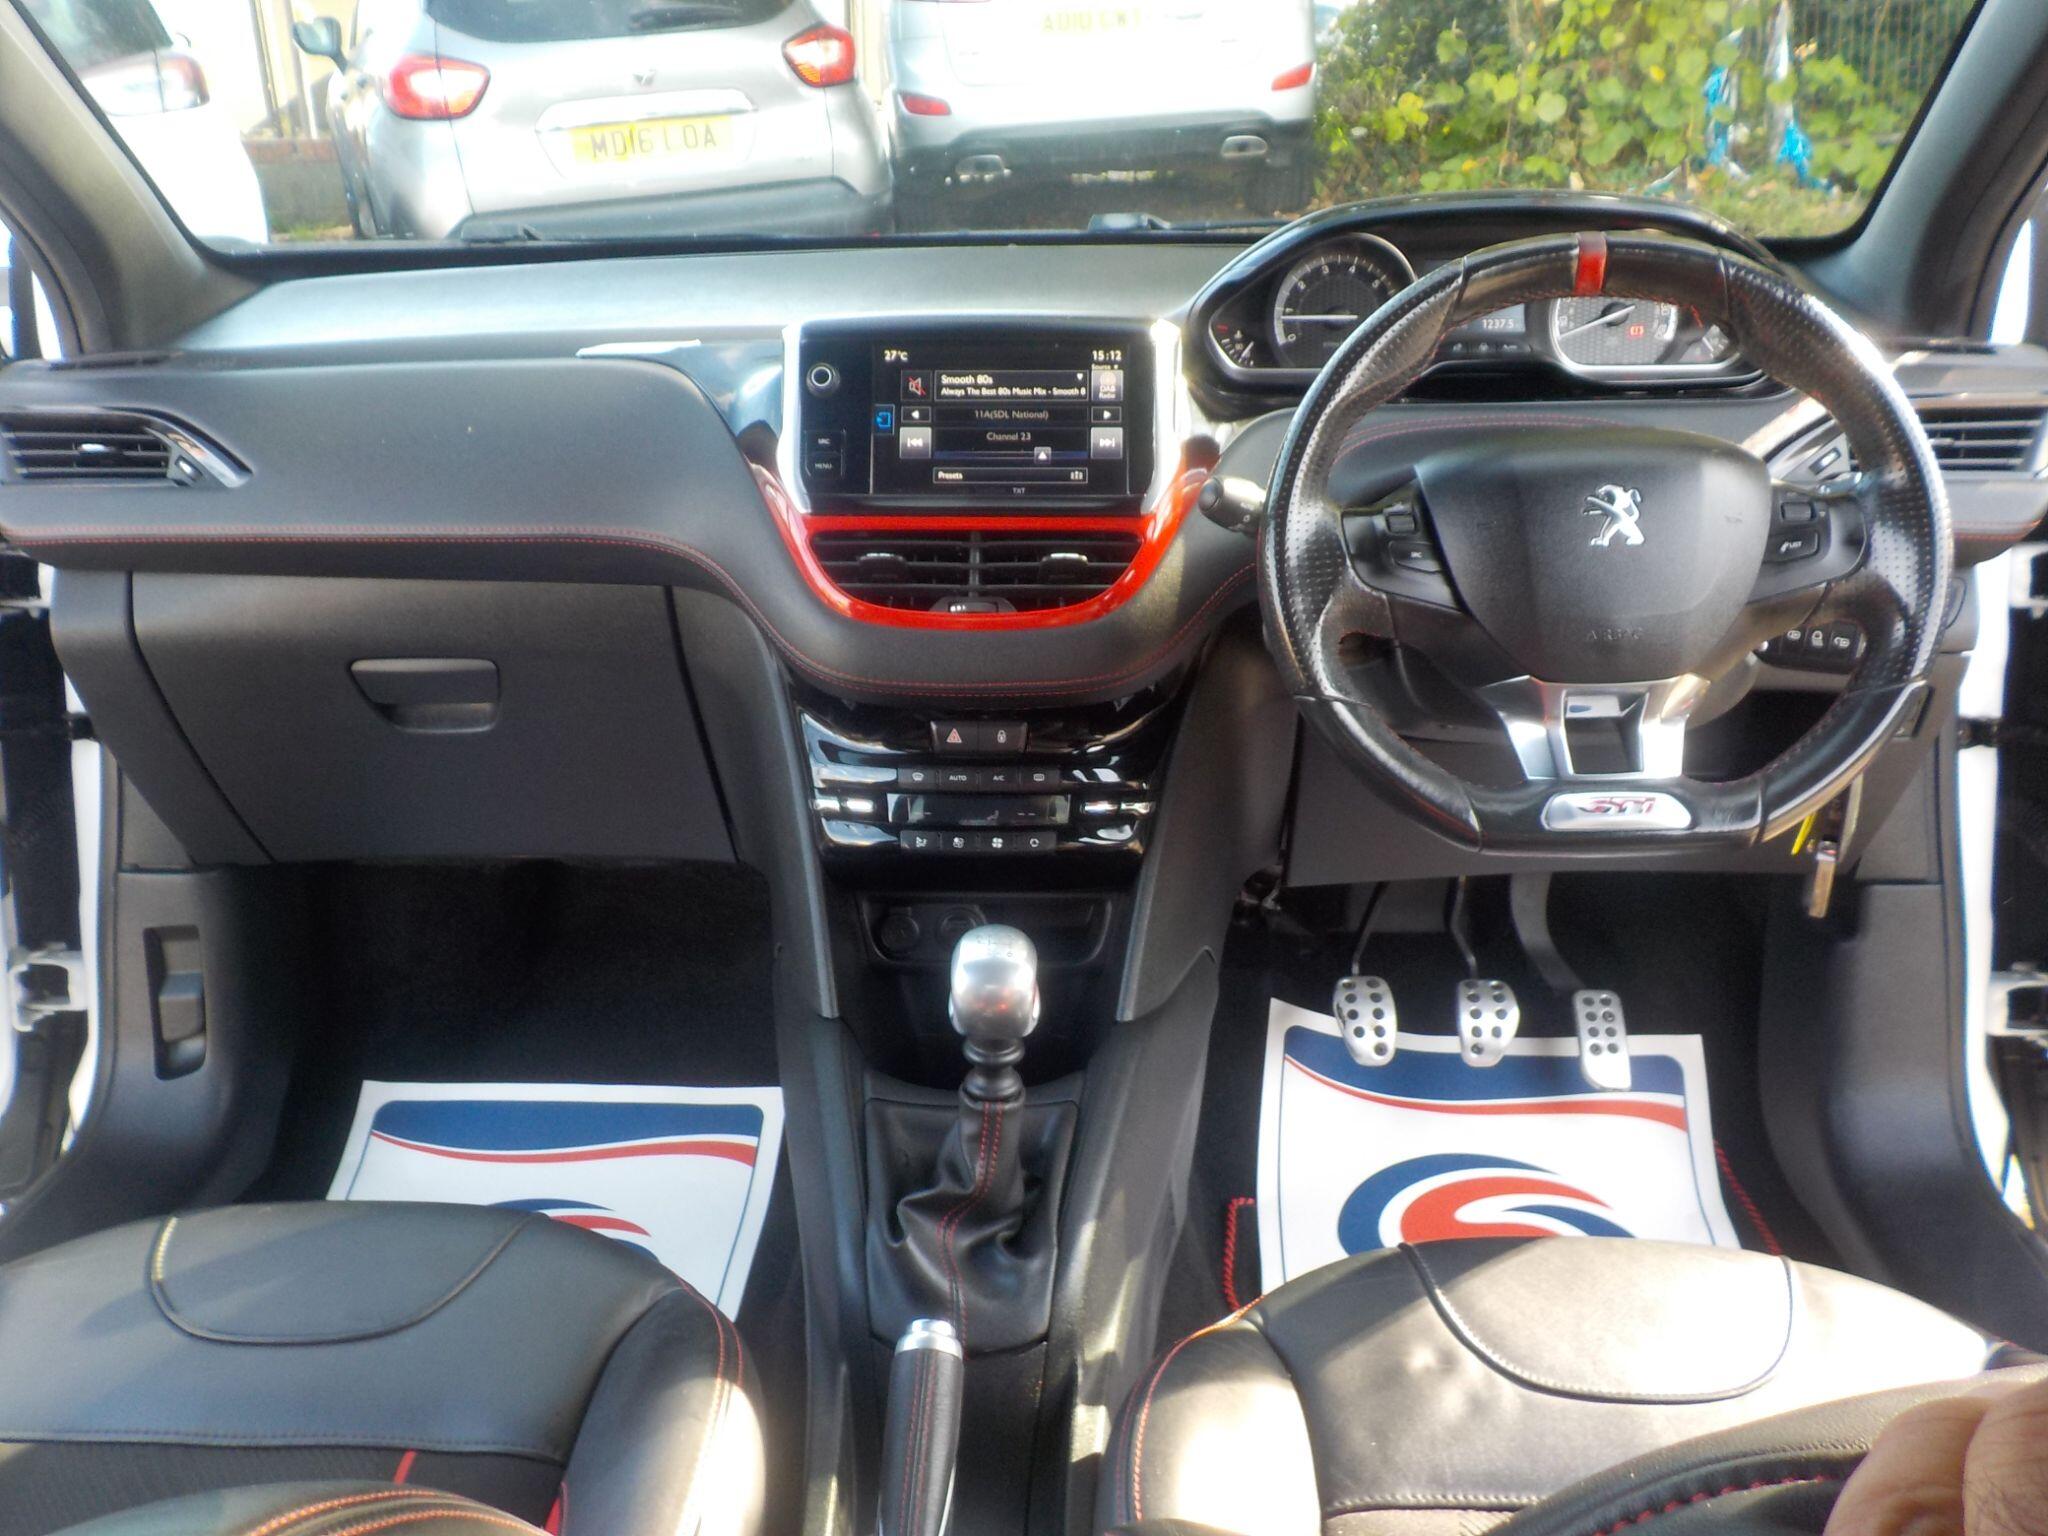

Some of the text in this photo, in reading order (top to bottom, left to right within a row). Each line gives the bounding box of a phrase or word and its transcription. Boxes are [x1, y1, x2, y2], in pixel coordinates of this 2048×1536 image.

[1092, 350, 1122, 361] 15:12
[941, 374, 975, 384] Smooth
[941, 387, 965, 396] Always
[967, 387, 980, 395] The
[981, 387, 997, 395] Best
[1012, 387, 1032, 395] Music
[1033, 387, 1046, 395] Mix
[1052, 387, 1079, 395] Smooth
[1012, 409, 1049, 420] National)
[986, 432, 1032, 441] Channel 23
[938, 471, 963, 480] Presets
